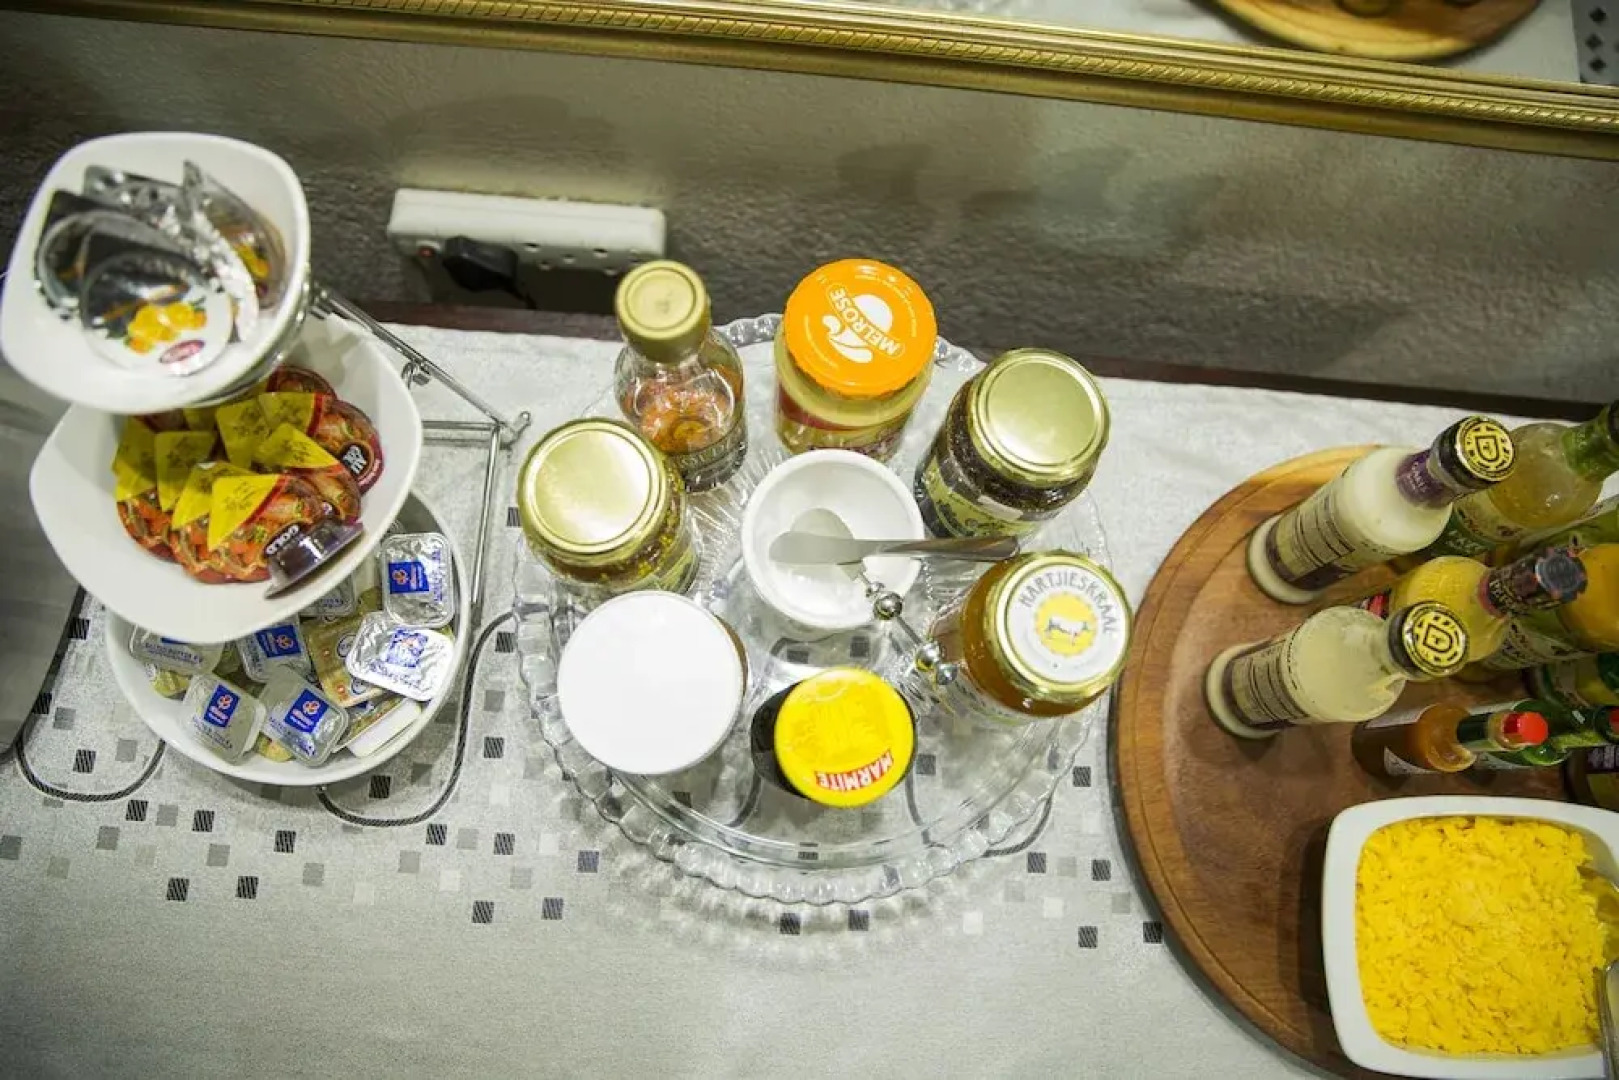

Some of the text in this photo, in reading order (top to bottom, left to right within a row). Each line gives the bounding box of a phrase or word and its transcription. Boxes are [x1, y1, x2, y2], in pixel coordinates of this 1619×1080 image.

[831, 286, 900, 355] MELROSE
[1018, 570, 1121, 633] HARTJIESKRAAL
[817, 749, 894, 791] MARMITE
